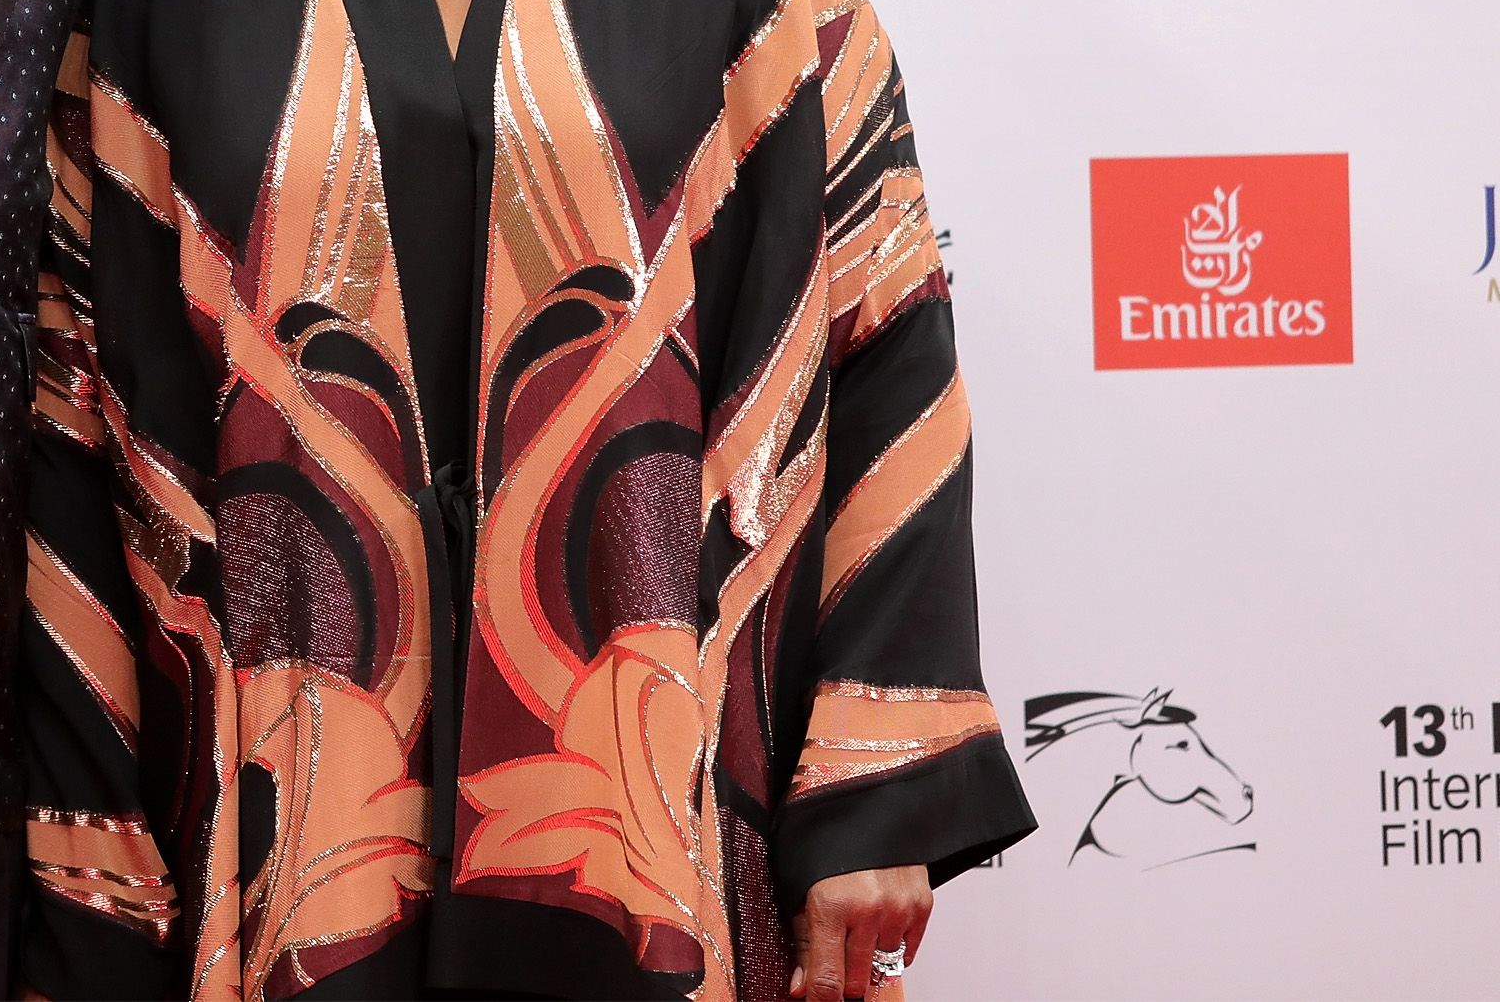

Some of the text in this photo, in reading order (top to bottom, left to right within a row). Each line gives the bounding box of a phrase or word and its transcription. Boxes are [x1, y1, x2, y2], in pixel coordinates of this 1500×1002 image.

[1119, 295, 1326, 341] Emirates
[1380, 704, 1473, 757] 13th
[1382, 819, 1481, 866] Film
